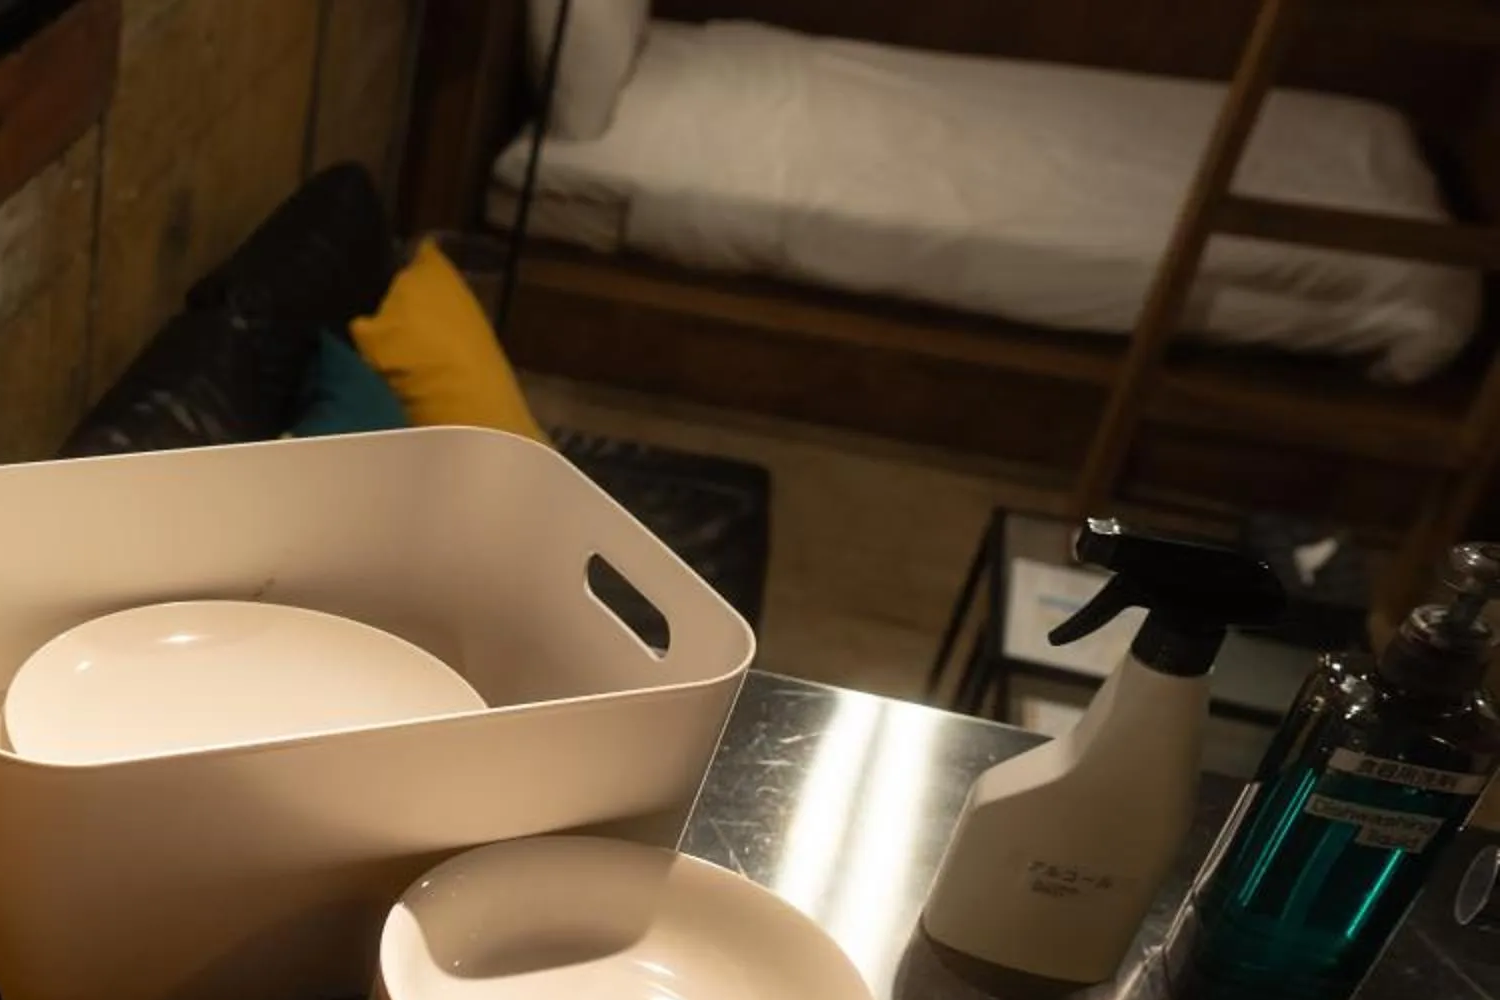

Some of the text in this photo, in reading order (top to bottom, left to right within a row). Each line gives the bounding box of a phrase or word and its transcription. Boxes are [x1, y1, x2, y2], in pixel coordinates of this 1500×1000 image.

[1027, 860, 1114, 890] アルコール
